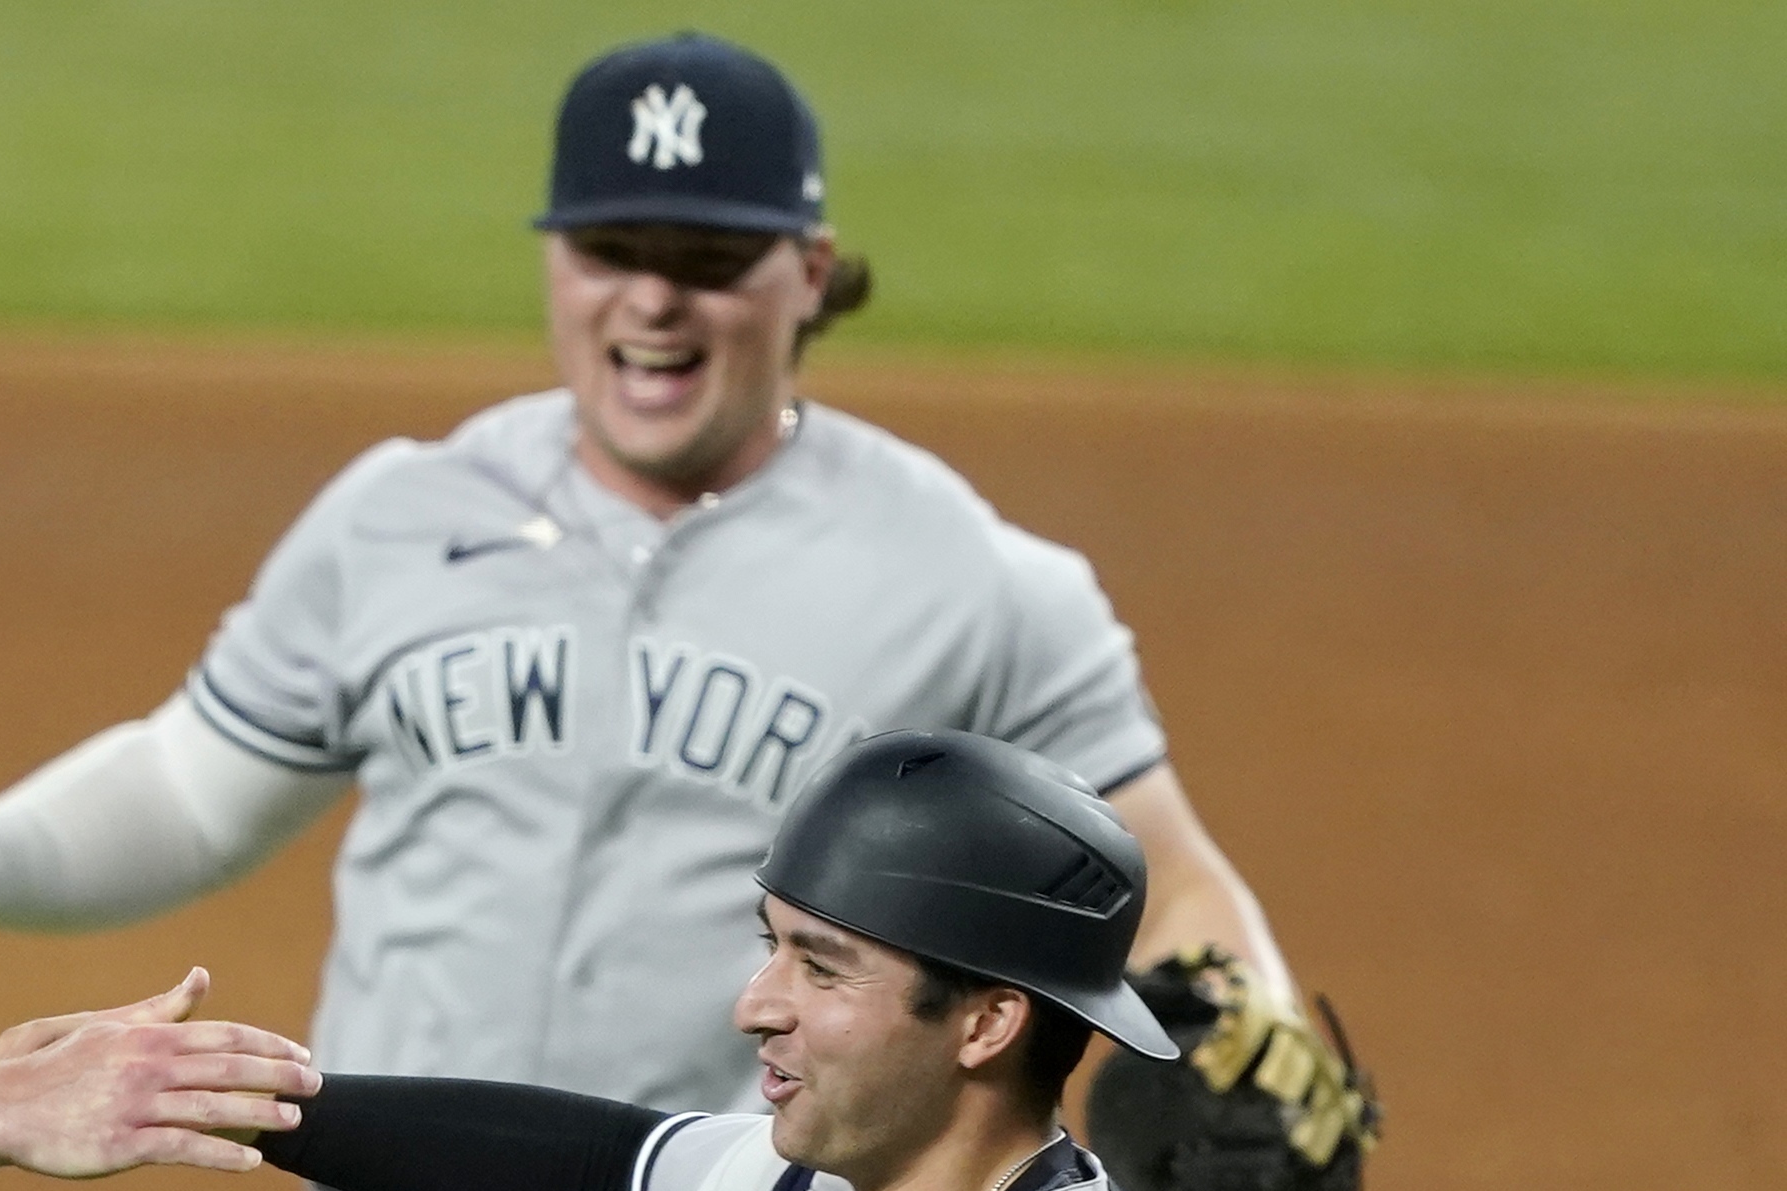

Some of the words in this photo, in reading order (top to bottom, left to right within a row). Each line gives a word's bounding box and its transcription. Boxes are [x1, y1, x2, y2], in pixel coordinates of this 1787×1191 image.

[627, 84, 708, 170] NY
[383, 632, 572, 770] NEW
[634, 644, 868, 811] YOR
